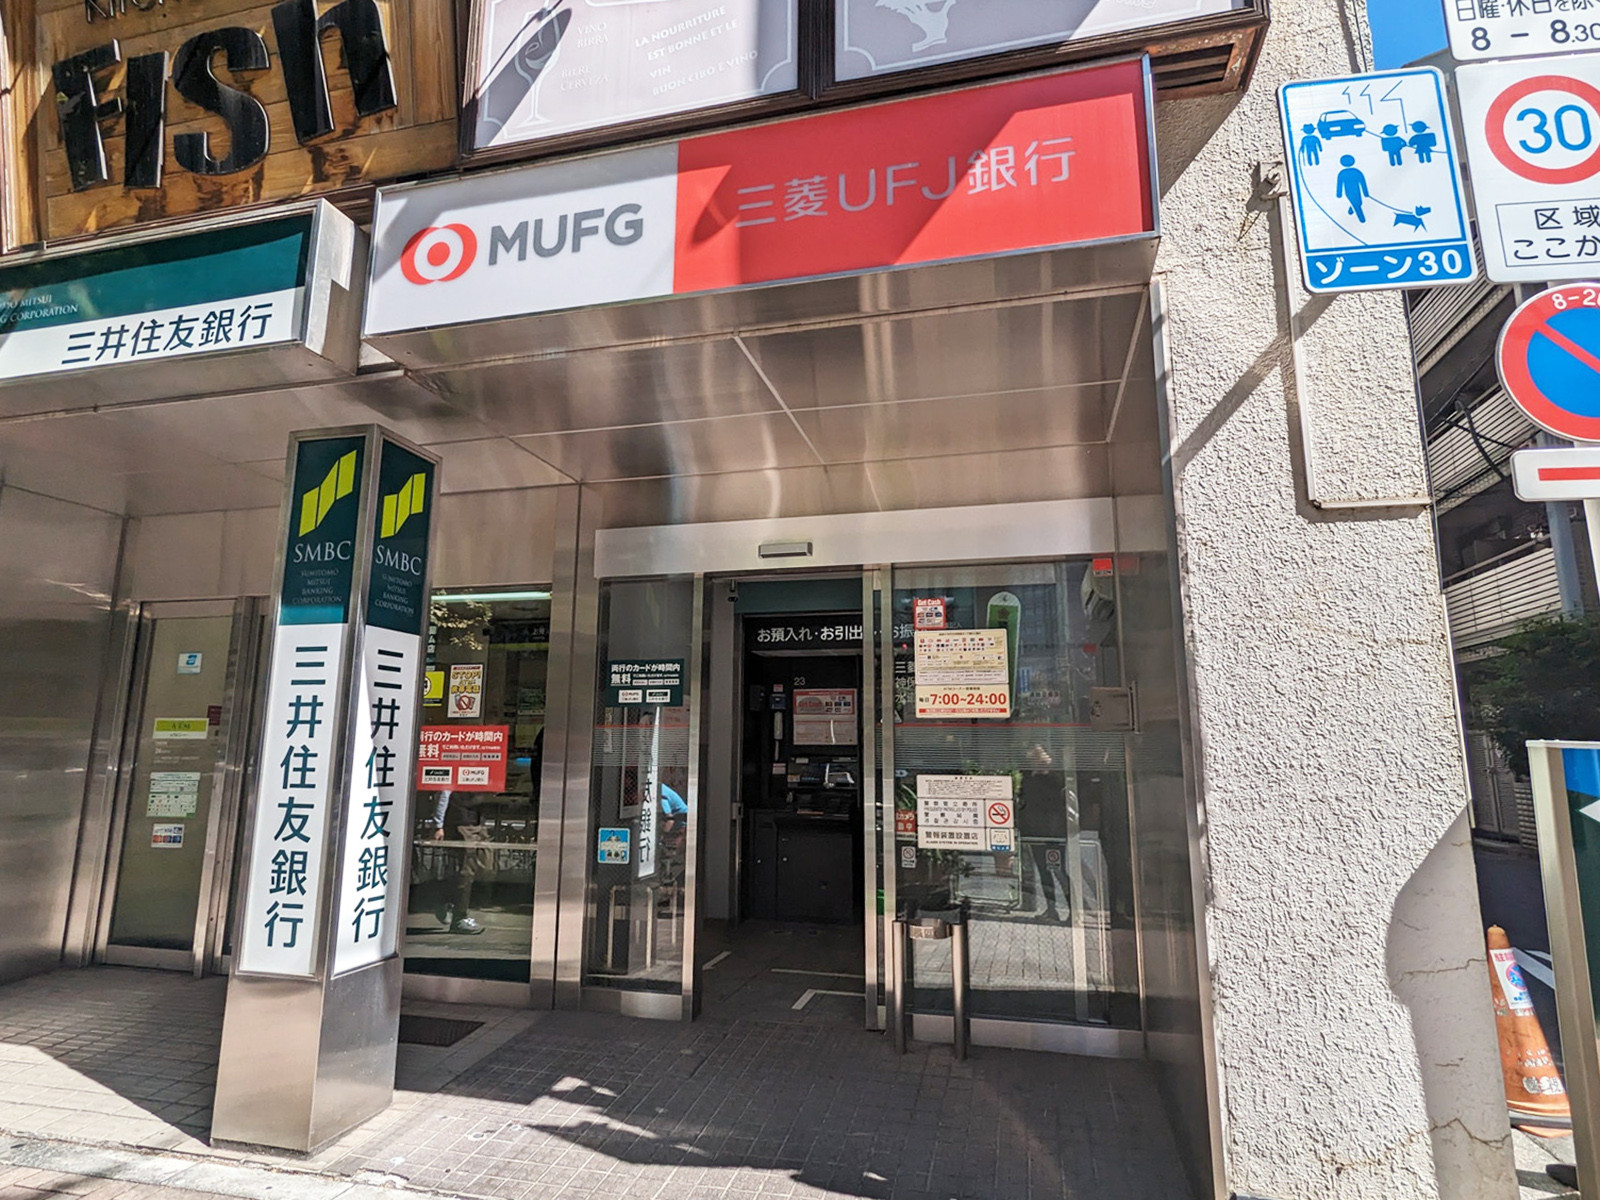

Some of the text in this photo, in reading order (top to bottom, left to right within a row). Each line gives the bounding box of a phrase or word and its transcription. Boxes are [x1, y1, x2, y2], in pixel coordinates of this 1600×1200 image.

[634, 5, 727, 48] LA NOURRITURE
[647, 19, 738, 61] EST BONNE ET LE
[1471, 27, 1491, 51] 8
[649, 64, 672, 79] VIN
[652, 76, 687, 96] BUON
[688, 66, 717, 83] CIBO
[726, 50, 759, 67] VINO
[1516, 104, 1593, 155] 30
[735, 136, 1077, 229] 三菱UFJ銀行
[487, 202, 645, 267] MUFG
[1315, 249, 1463, 285] ゾーン30
[9, 303, 79, 322] CORPORATION
[61, 302, 274, 365] 三井住友銀行
[293, 540, 352, 563] SMBC
[375, 544, 422, 576] SMBC
[793, 677, 806, 686] 23
[264, 645, 328, 948] 三井住友銀行
[351, 648, 404, 943] 三井住友銀行
